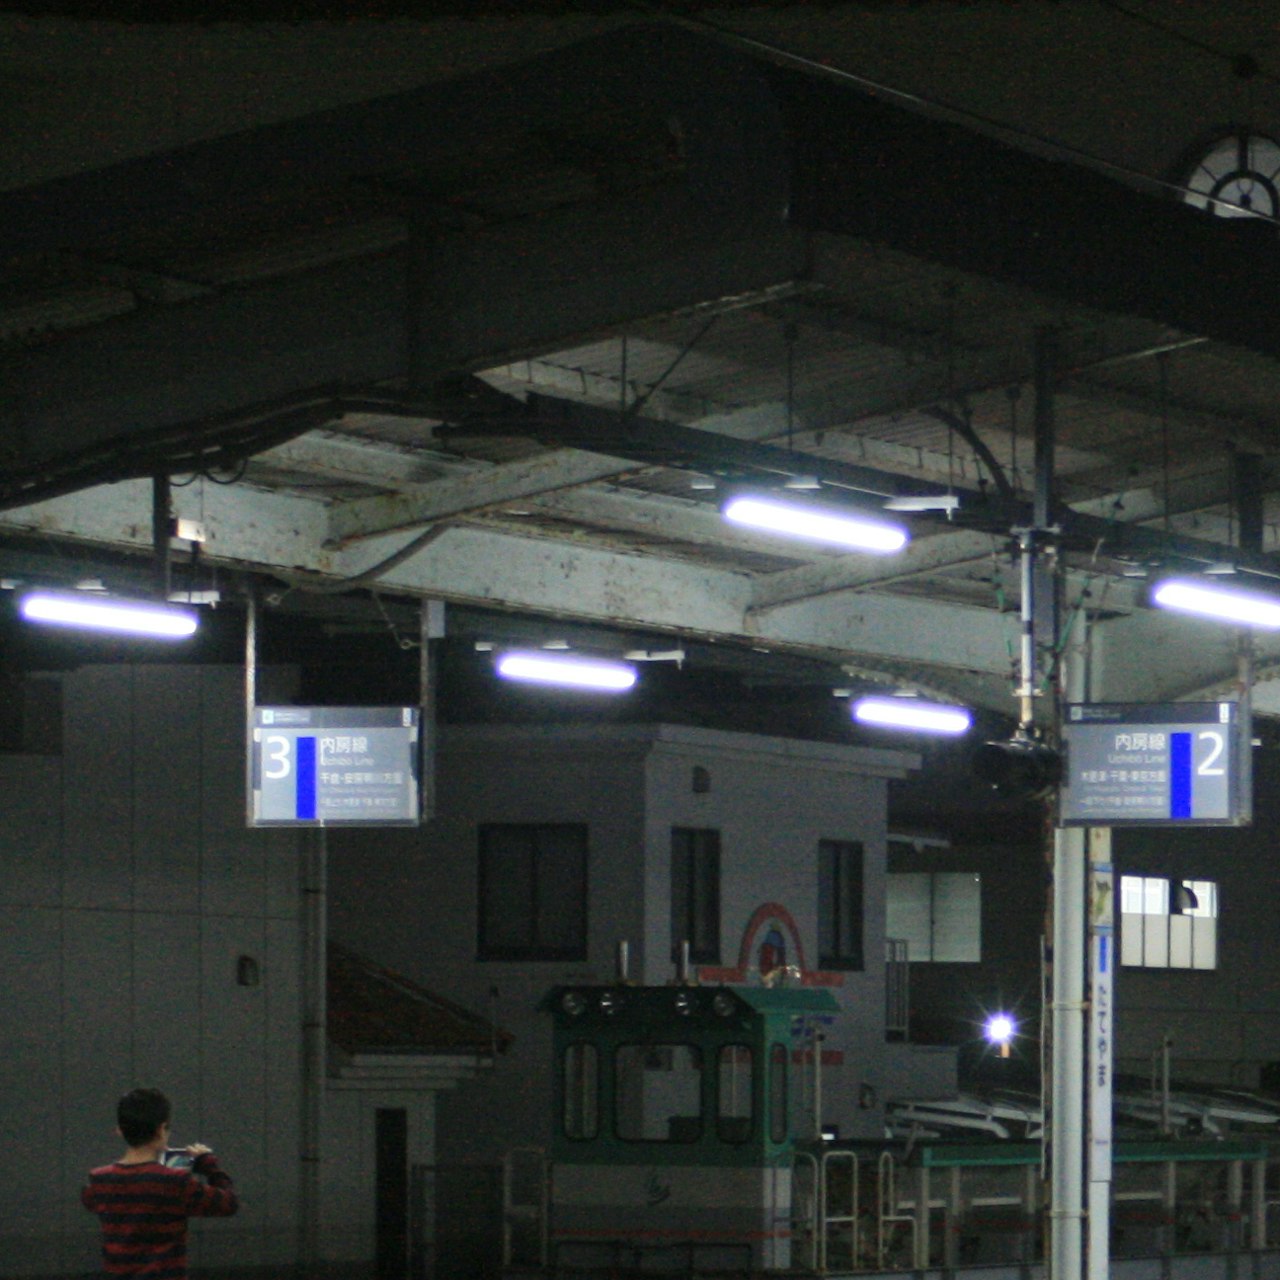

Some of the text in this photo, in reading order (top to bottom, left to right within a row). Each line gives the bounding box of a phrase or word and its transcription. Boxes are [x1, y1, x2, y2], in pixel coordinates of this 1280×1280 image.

[265, 735, 291, 779] 3
[320, 736, 368, 754] 内房線
[1115, 733, 1166, 751] 内房線
[1197, 731, 1224, 776] 2
